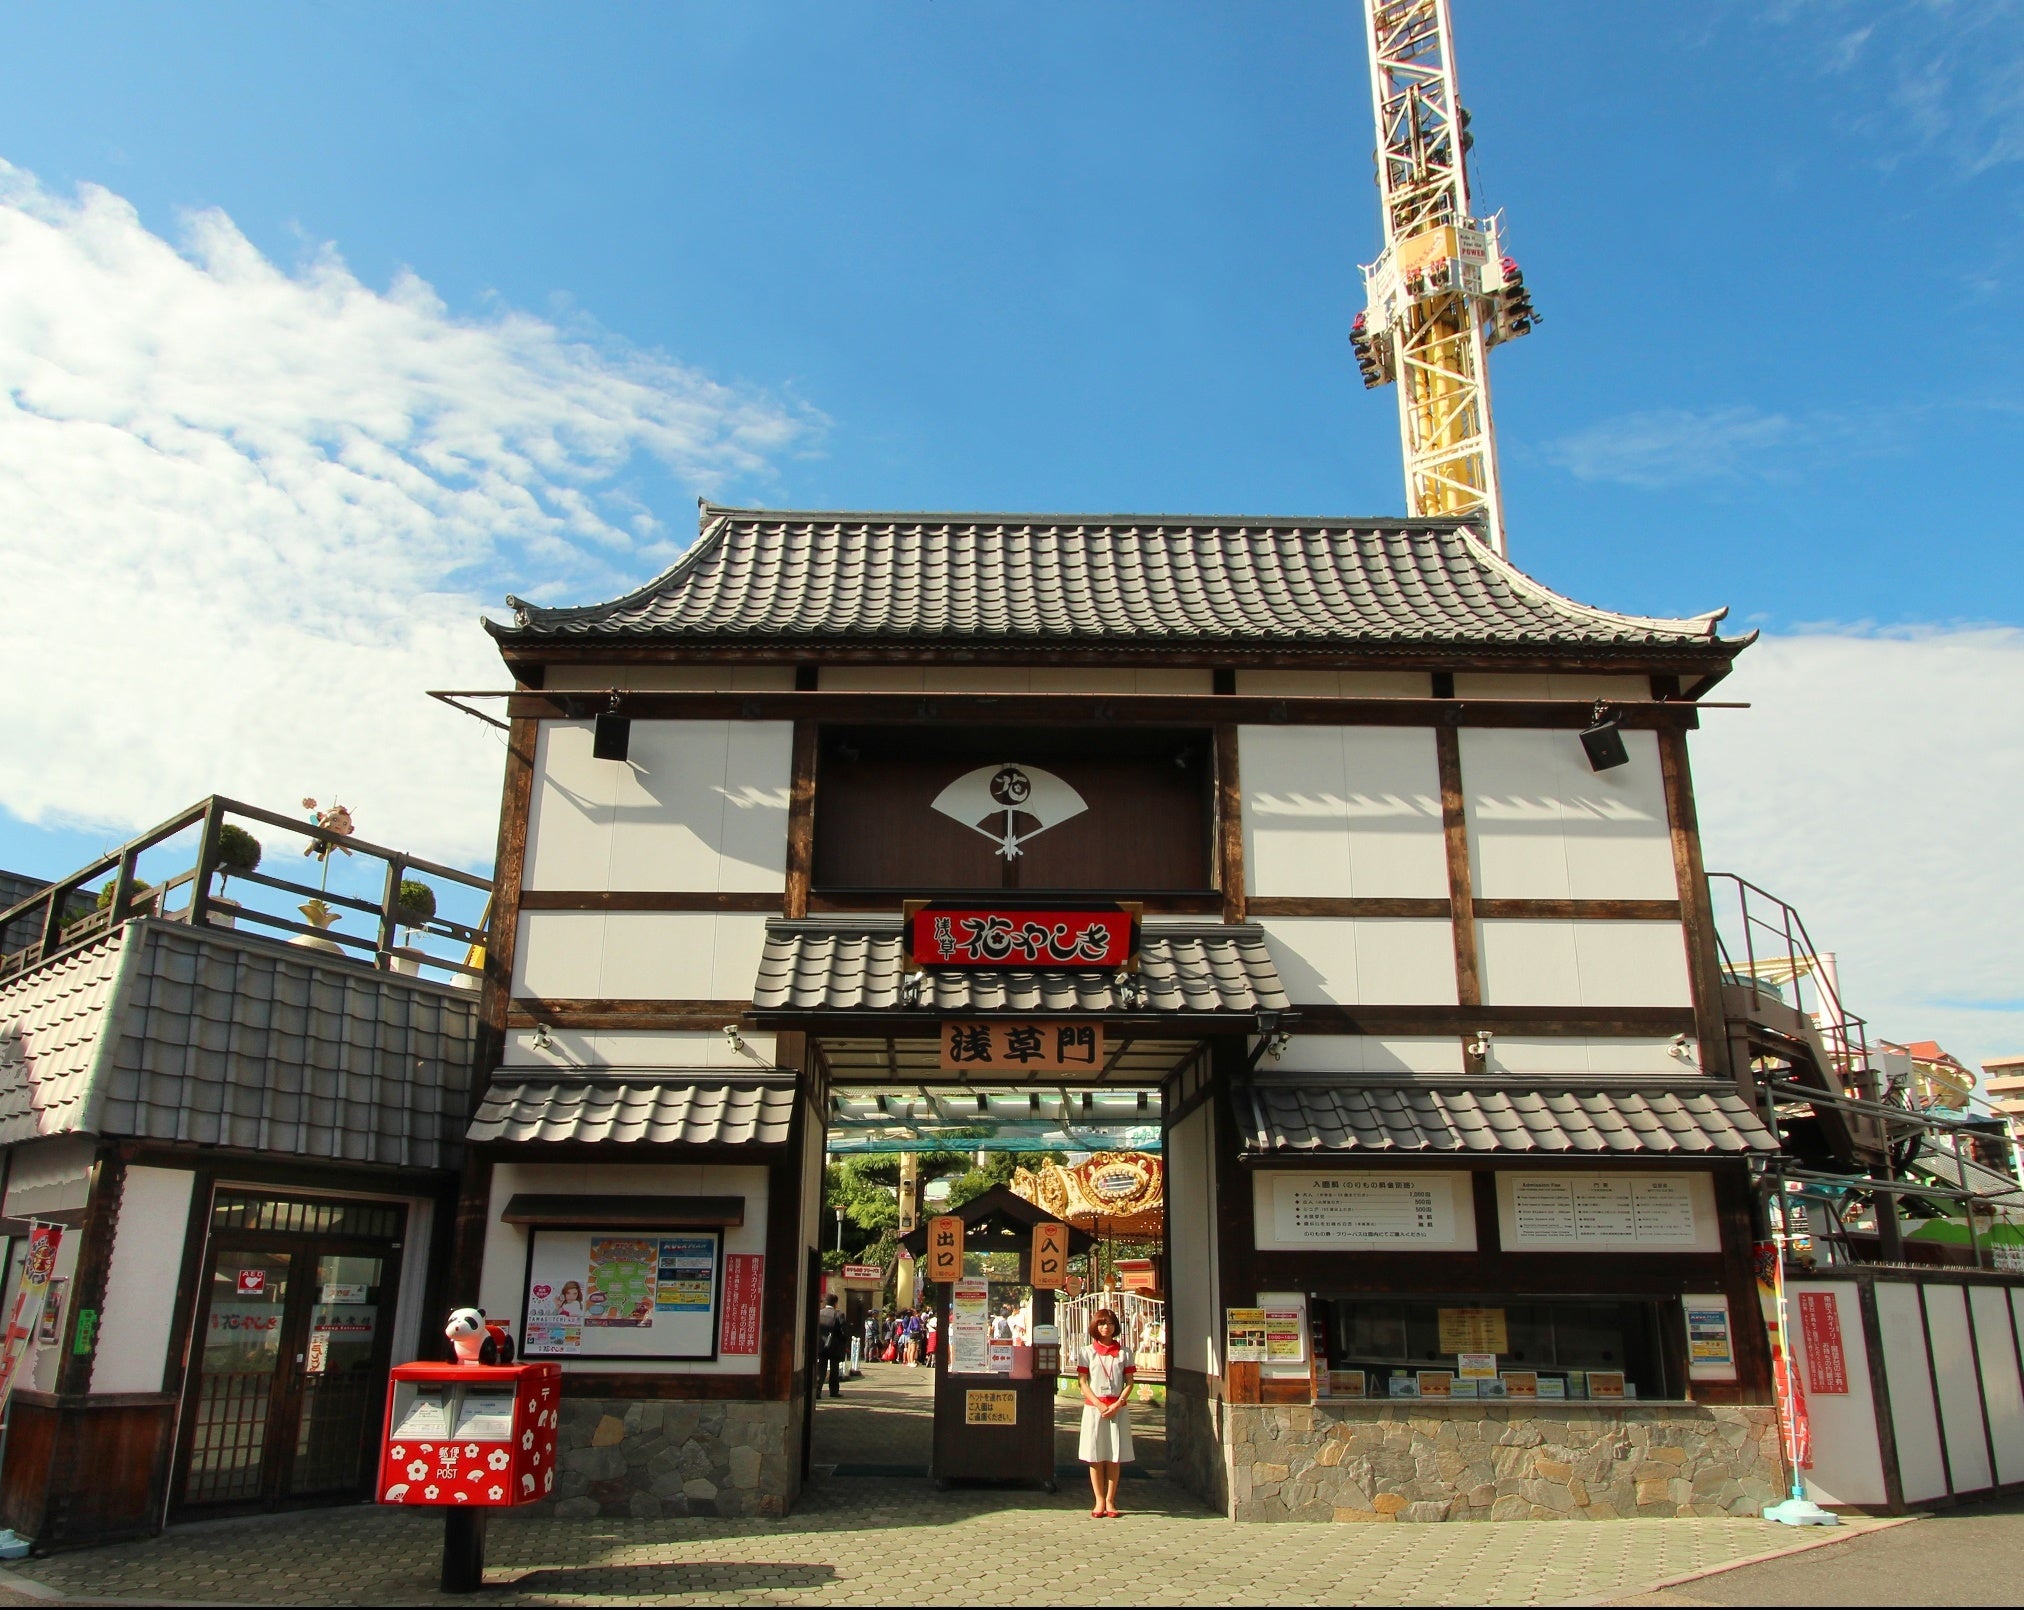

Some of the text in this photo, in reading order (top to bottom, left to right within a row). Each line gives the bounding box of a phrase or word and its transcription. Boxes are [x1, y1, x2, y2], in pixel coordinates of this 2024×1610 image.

[1462, 248, 1485, 257] POWER
[934, 915, 1111, 961] 浅草 花やしき
[950, 1025, 1096, 1064] 浅草門
[937, 1231, 955, 1267] 出口
[1041, 1237, 1060, 1274] 入口
[438, 1446, 460, 1459] 郵便
[436, 1469, 458, 1479] POST
